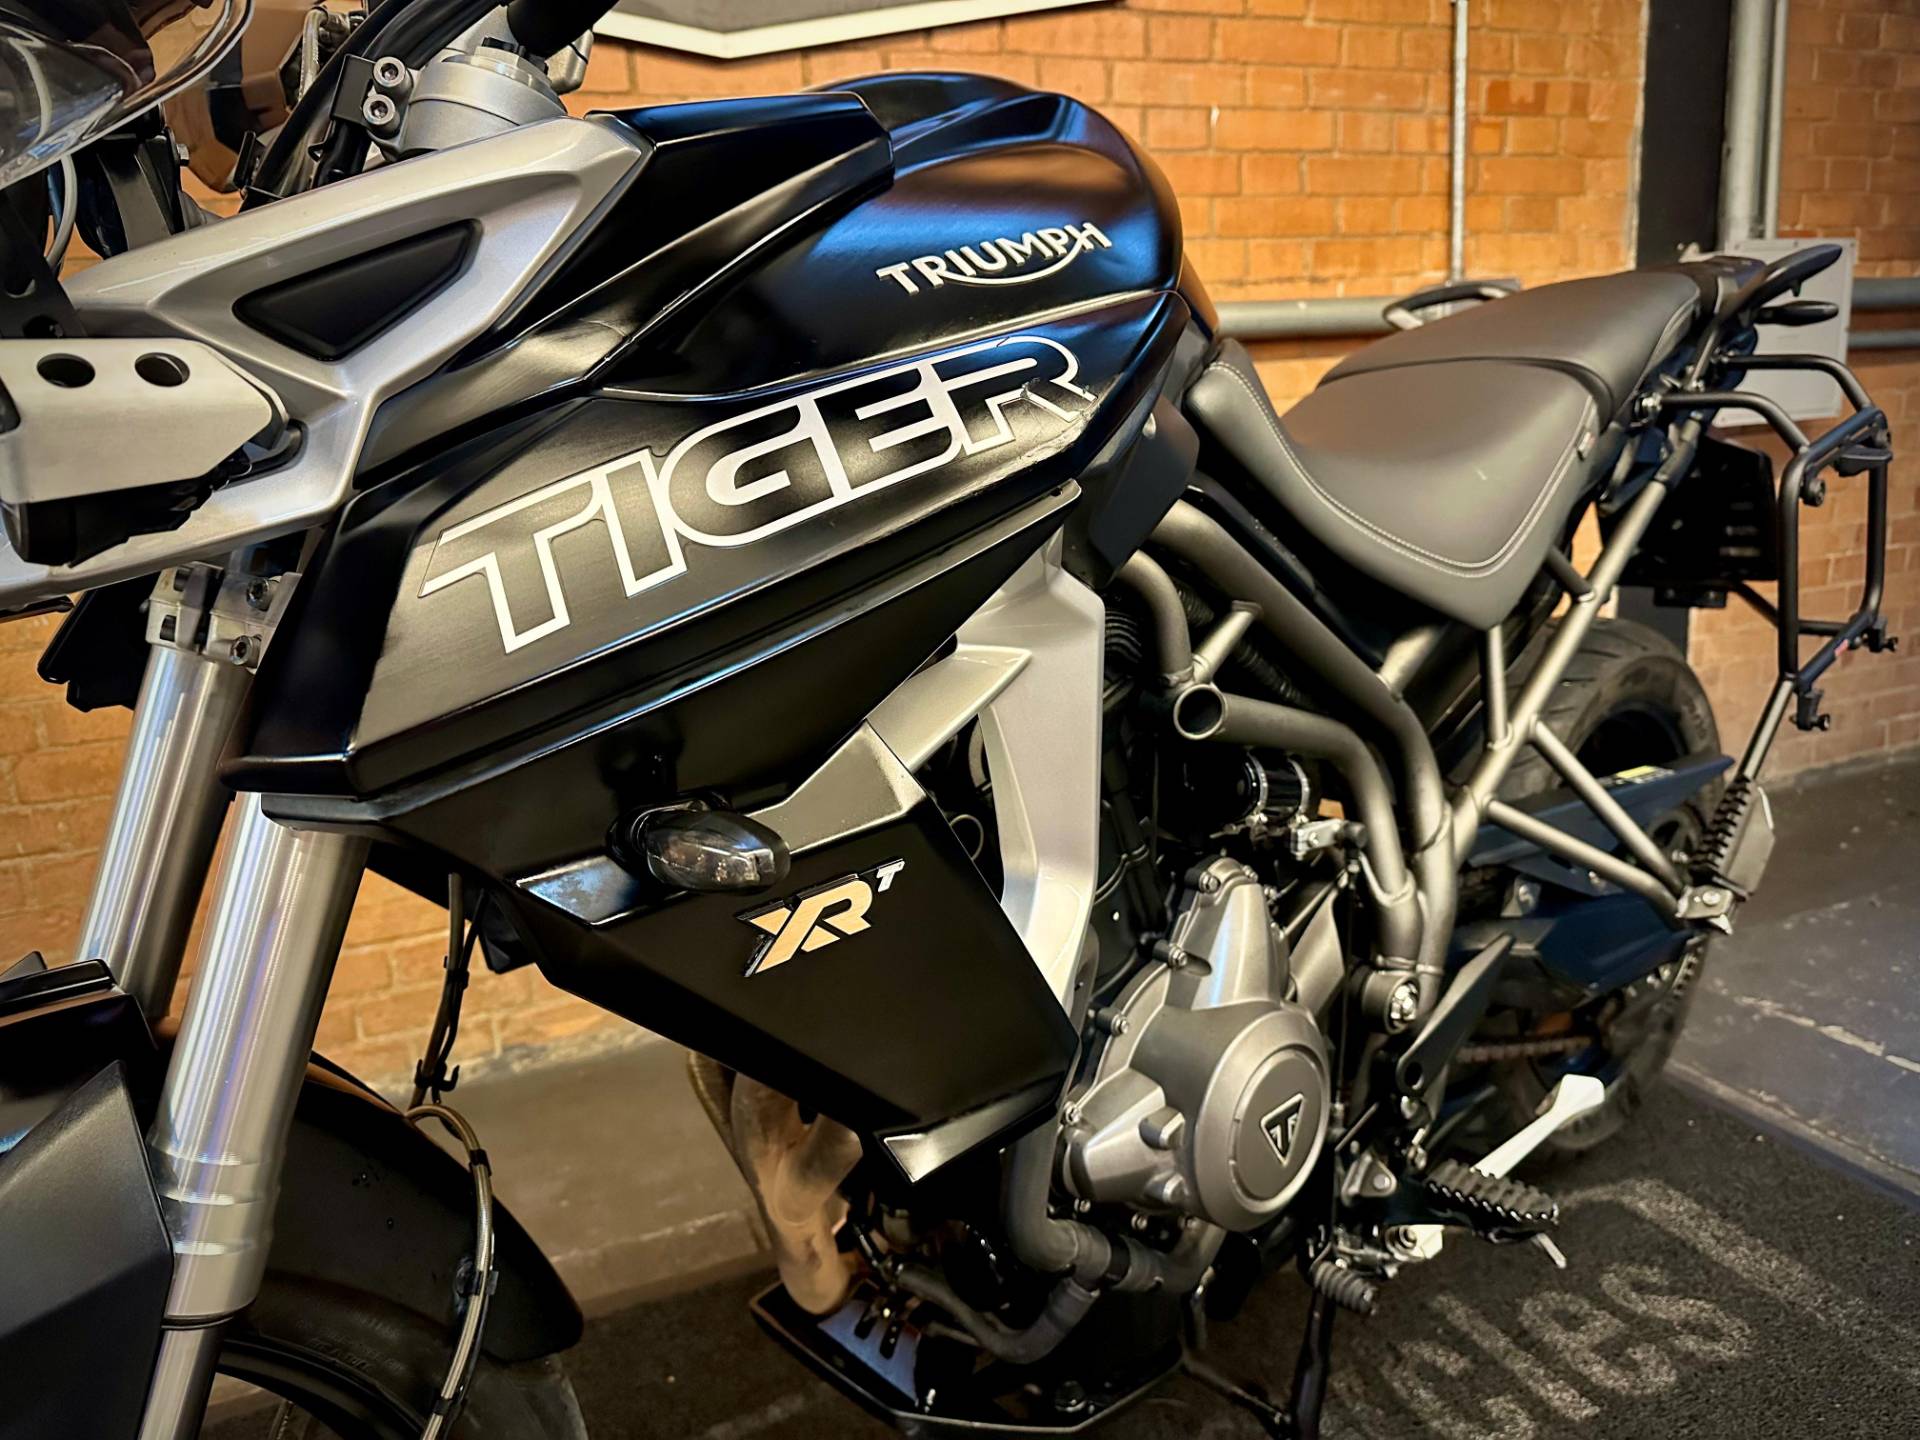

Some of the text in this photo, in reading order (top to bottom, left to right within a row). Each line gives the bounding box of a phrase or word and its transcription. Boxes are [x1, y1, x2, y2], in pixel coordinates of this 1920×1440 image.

[876, 221, 1112, 296] TRIUMPH
[418, 335, 1098, 654] TIGER
[1322, 1264, 1756, 1440] cles
